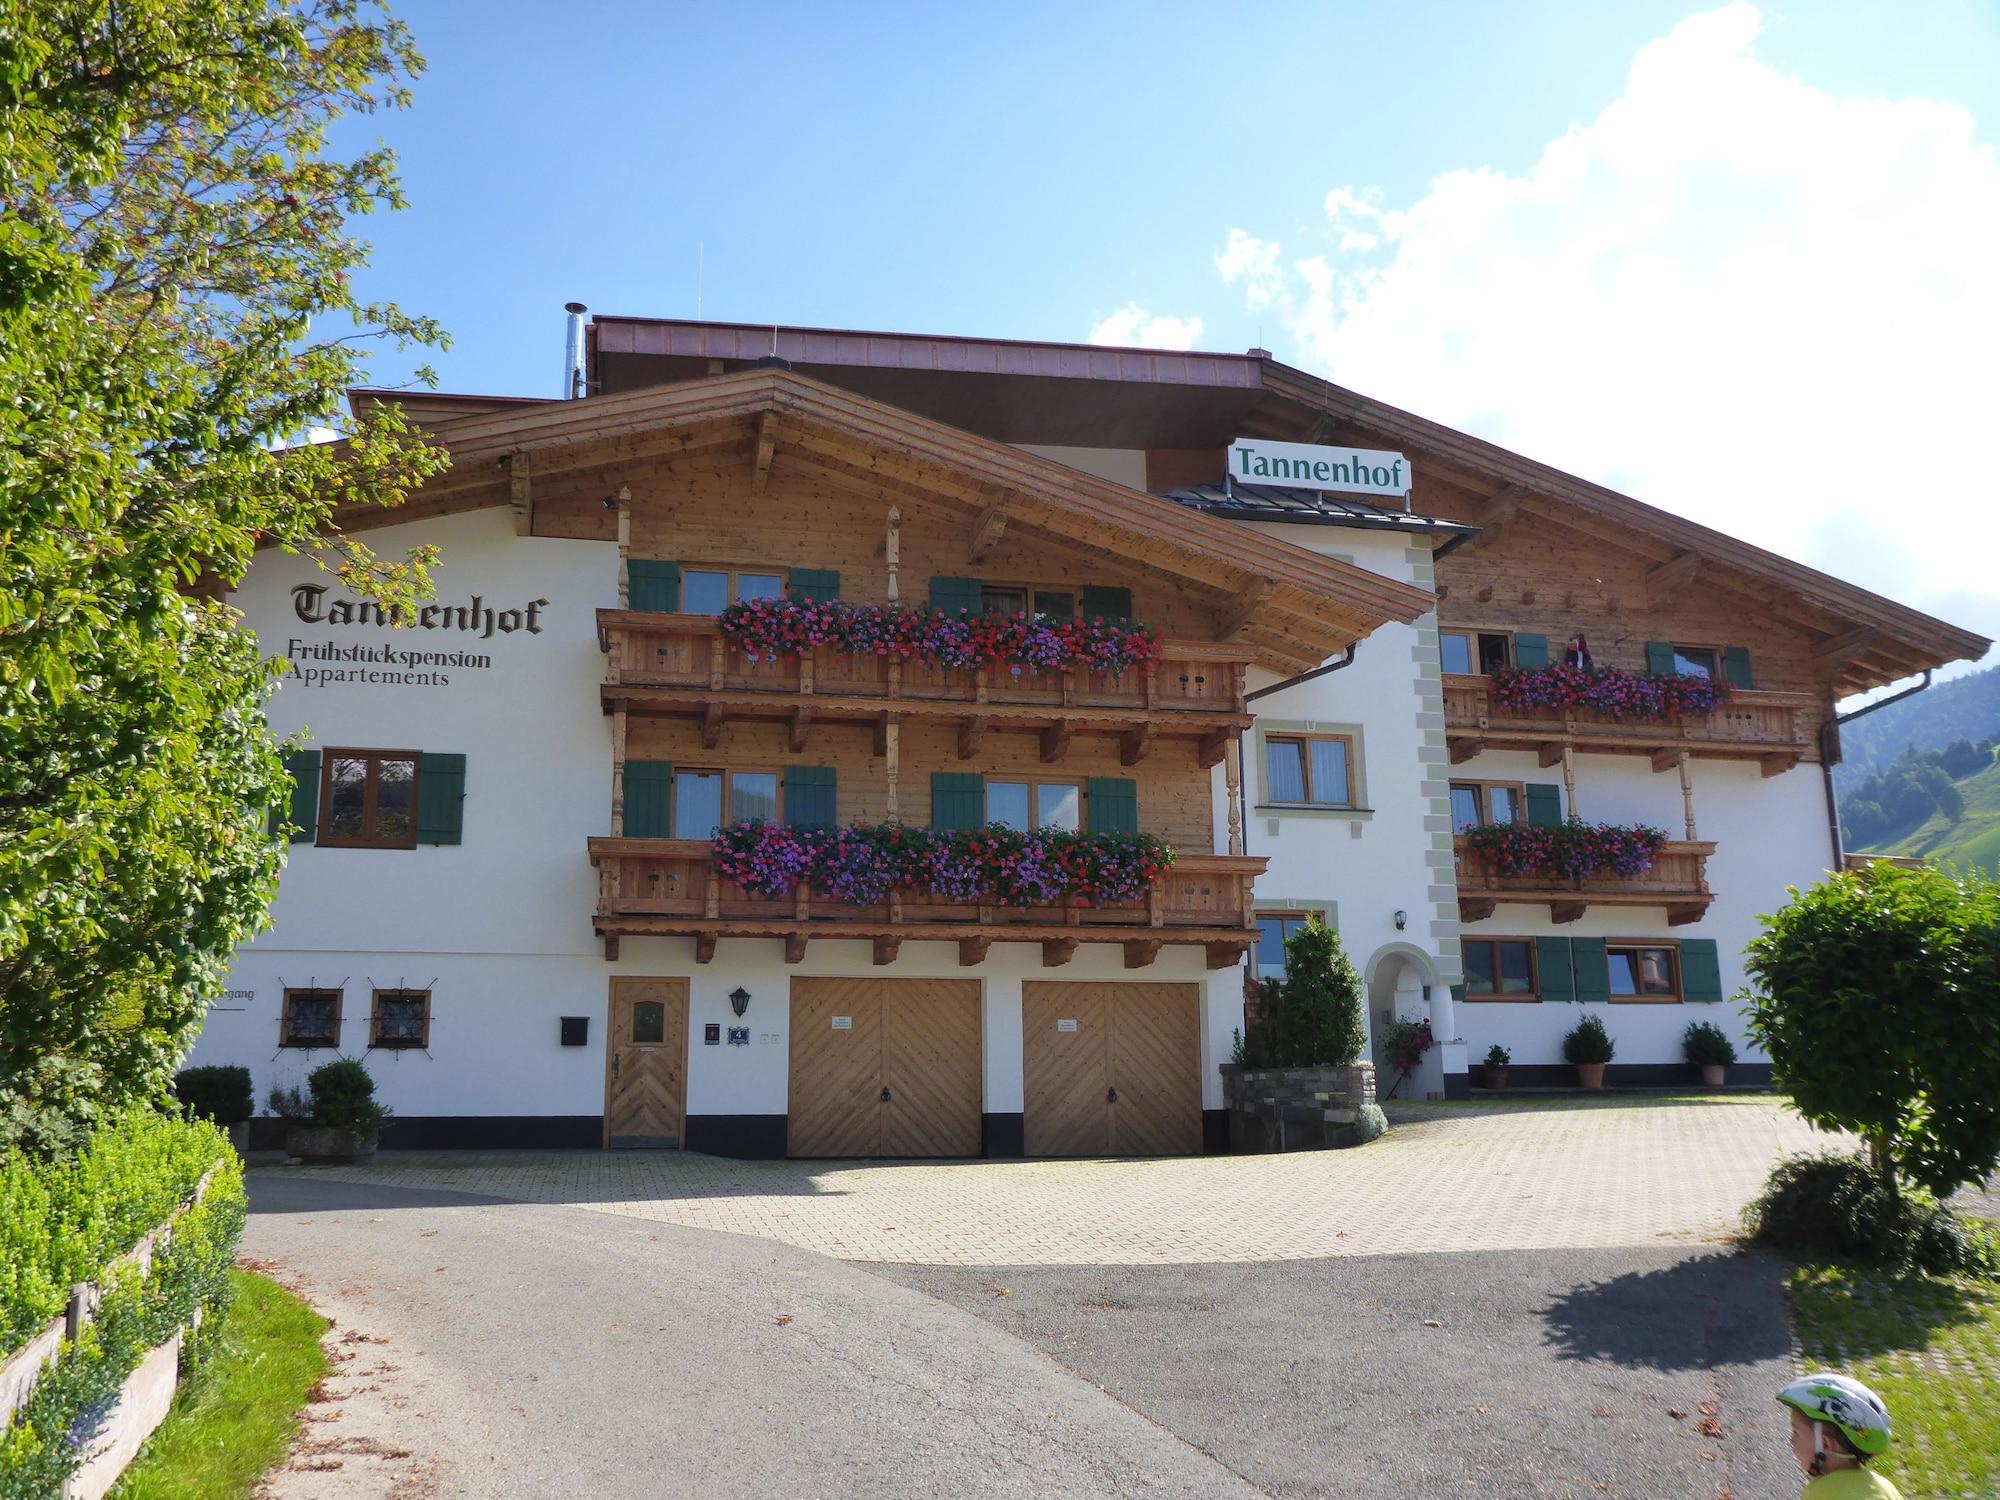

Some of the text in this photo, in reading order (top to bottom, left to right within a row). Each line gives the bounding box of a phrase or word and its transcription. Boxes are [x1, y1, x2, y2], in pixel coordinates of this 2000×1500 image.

[1235, 447, 1402, 488] Tannenhof
[287, 638, 492, 669] Frühstückspension
[286, 661, 450, 687] Appartements
